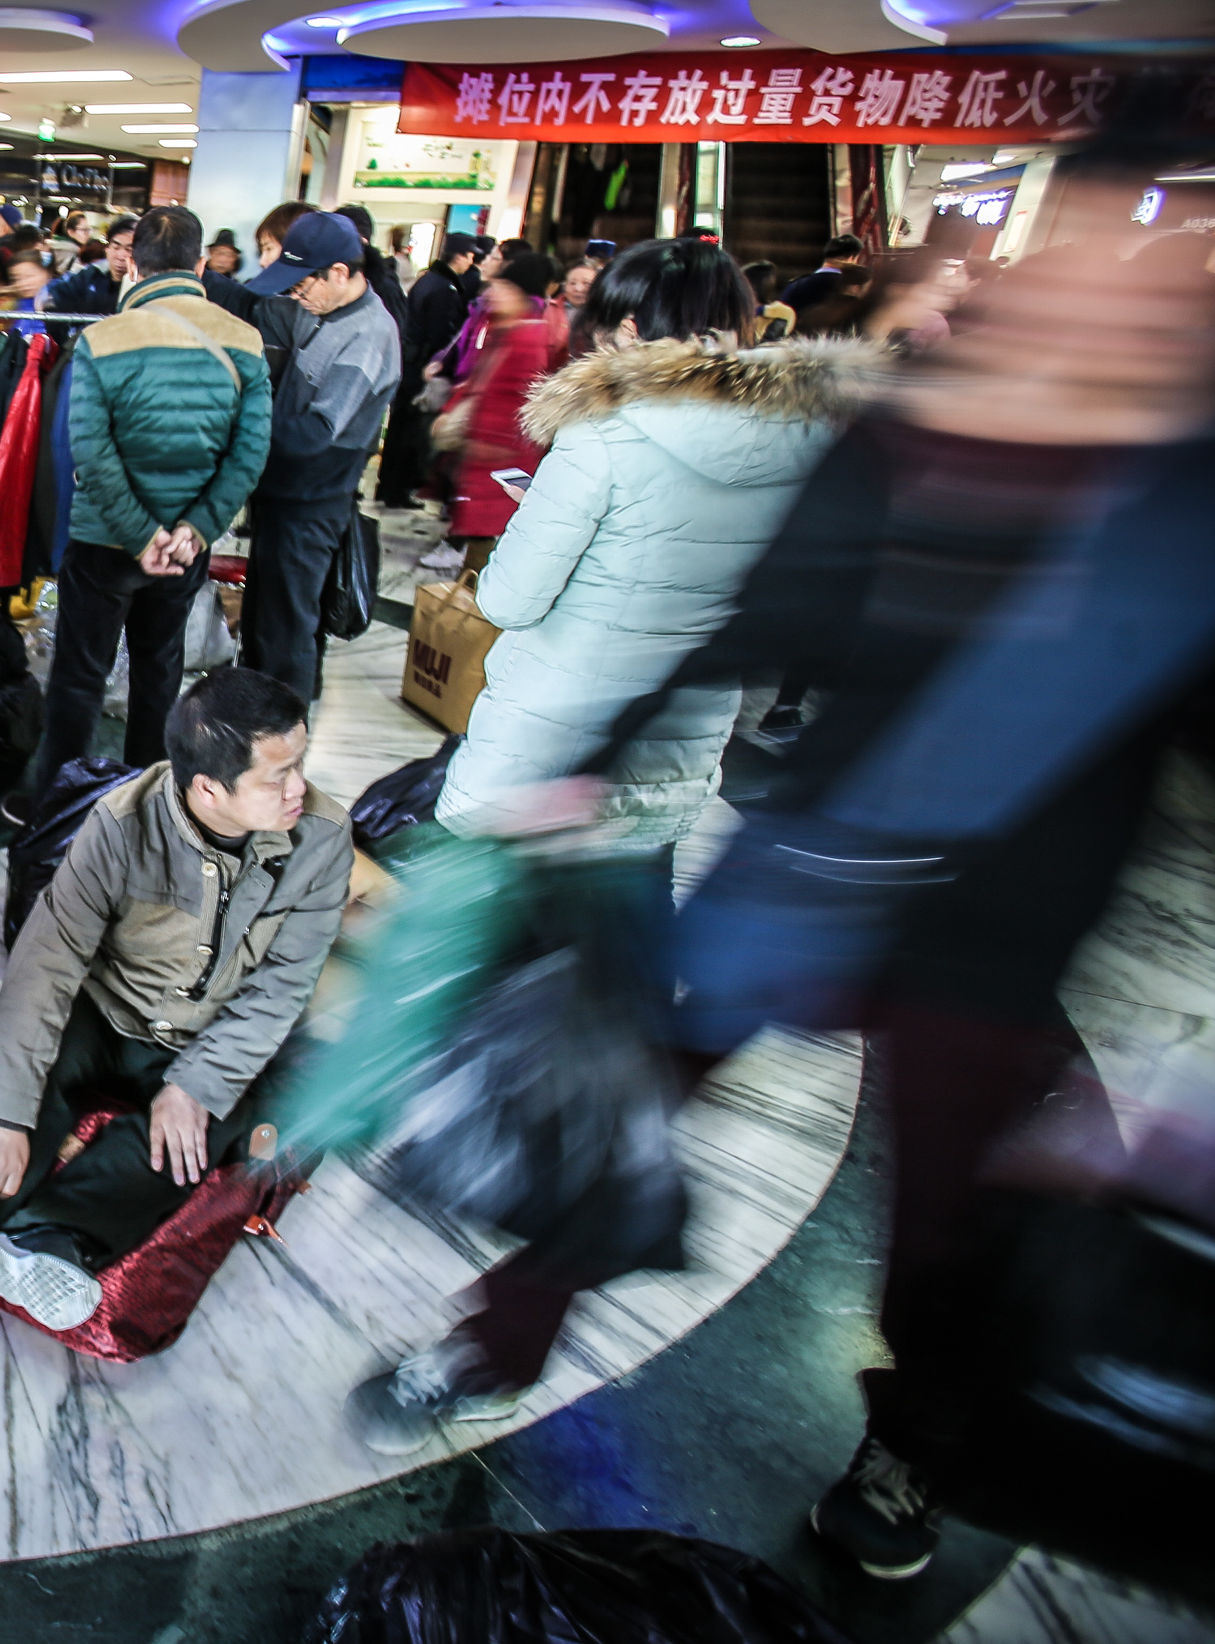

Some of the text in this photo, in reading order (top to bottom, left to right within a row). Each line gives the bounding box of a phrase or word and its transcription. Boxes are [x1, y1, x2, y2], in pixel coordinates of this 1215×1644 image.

[453, 68, 1215, 128] 摊位内不存放过量货物降低火灾
